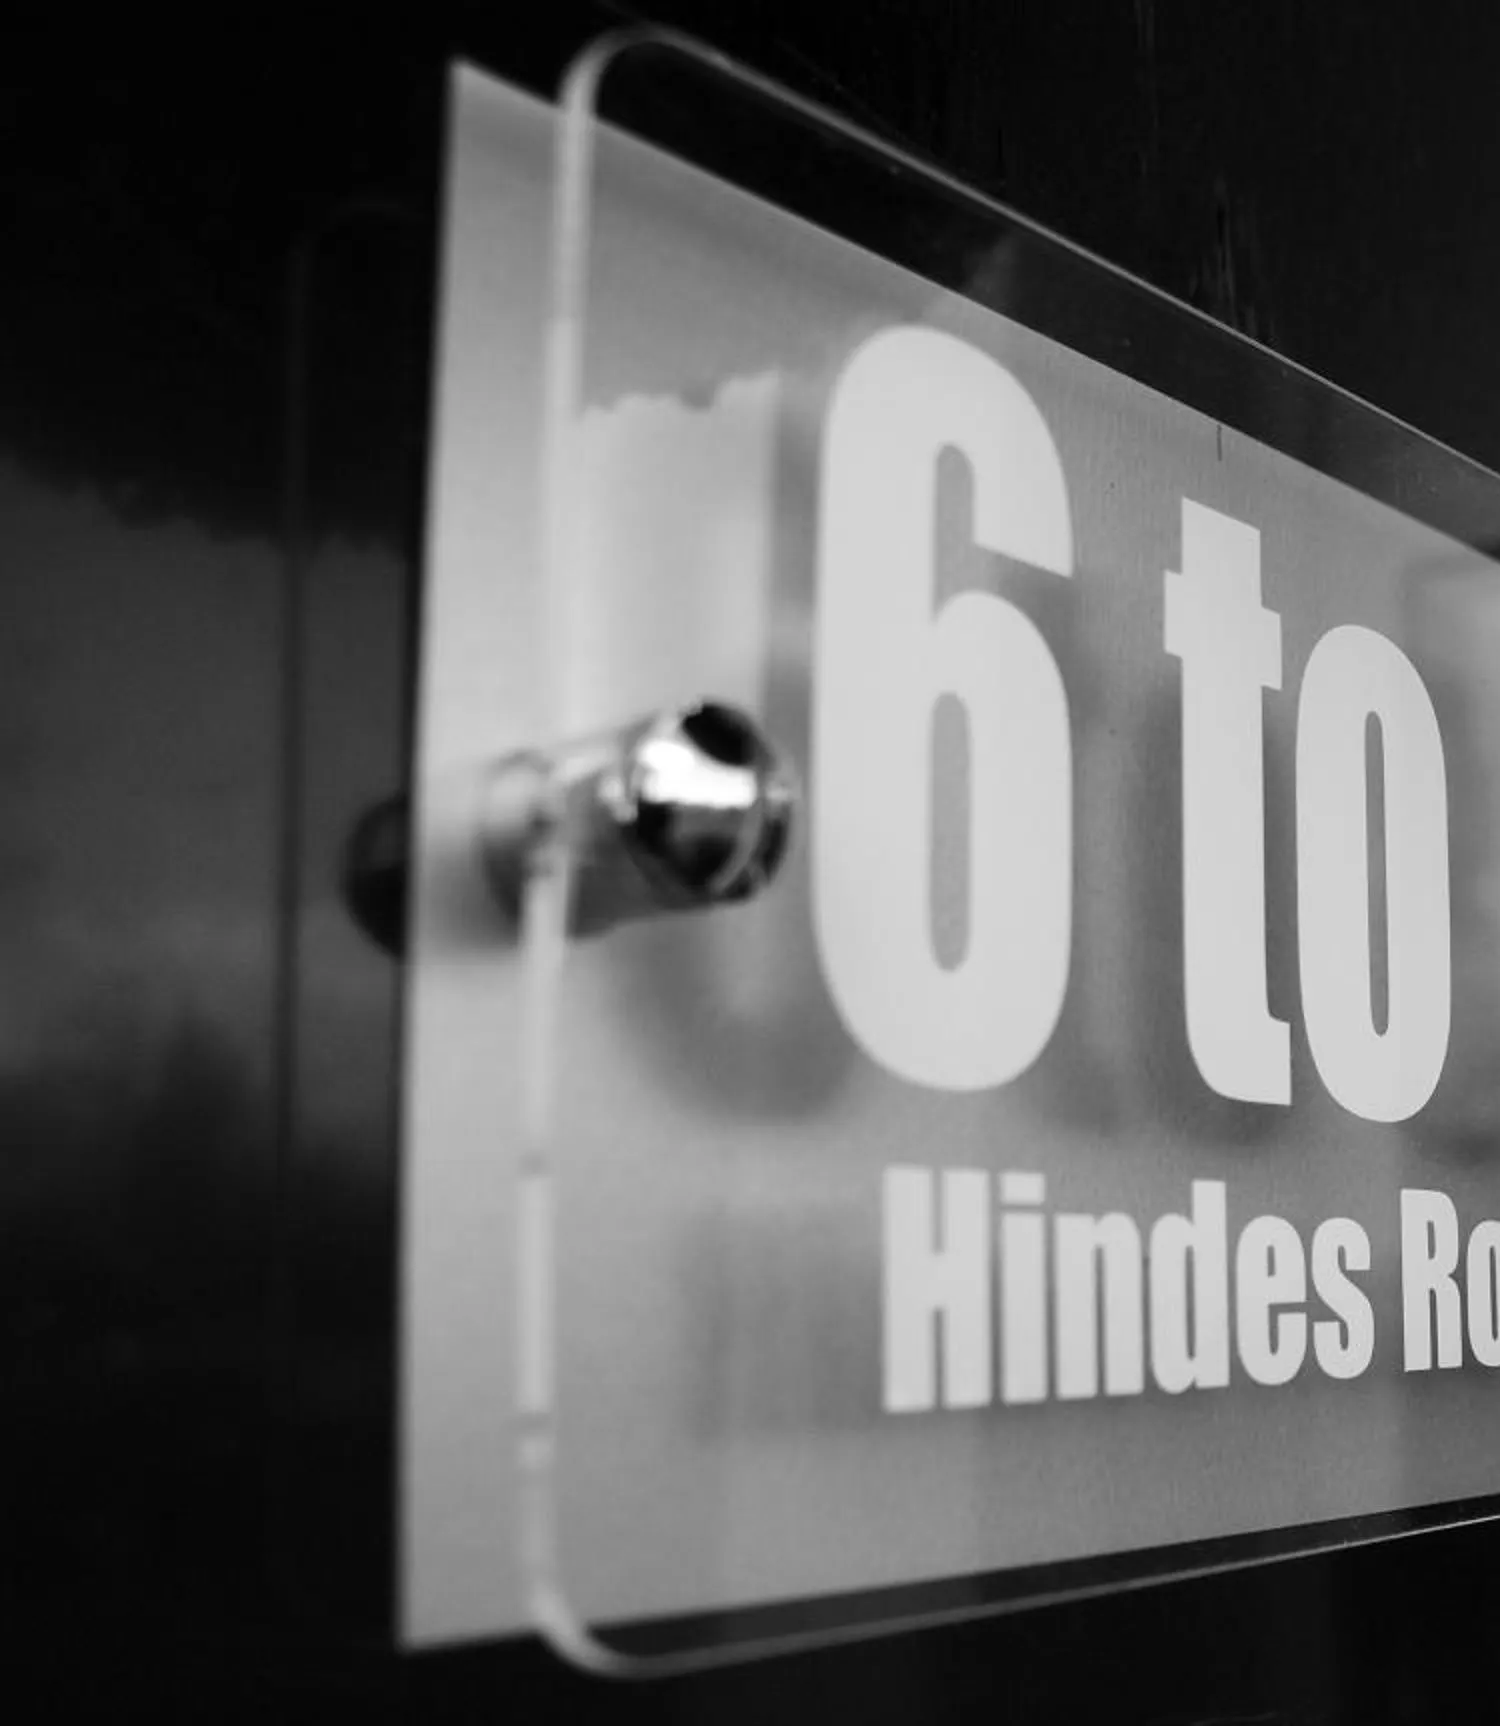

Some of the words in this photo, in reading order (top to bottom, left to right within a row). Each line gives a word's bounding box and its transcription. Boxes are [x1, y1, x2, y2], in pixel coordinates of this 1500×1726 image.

[812, 325, 1074, 1092] 6
[1163, 497, 1453, 1123] to
[881, 1164, 1376, 1413] Hindes
